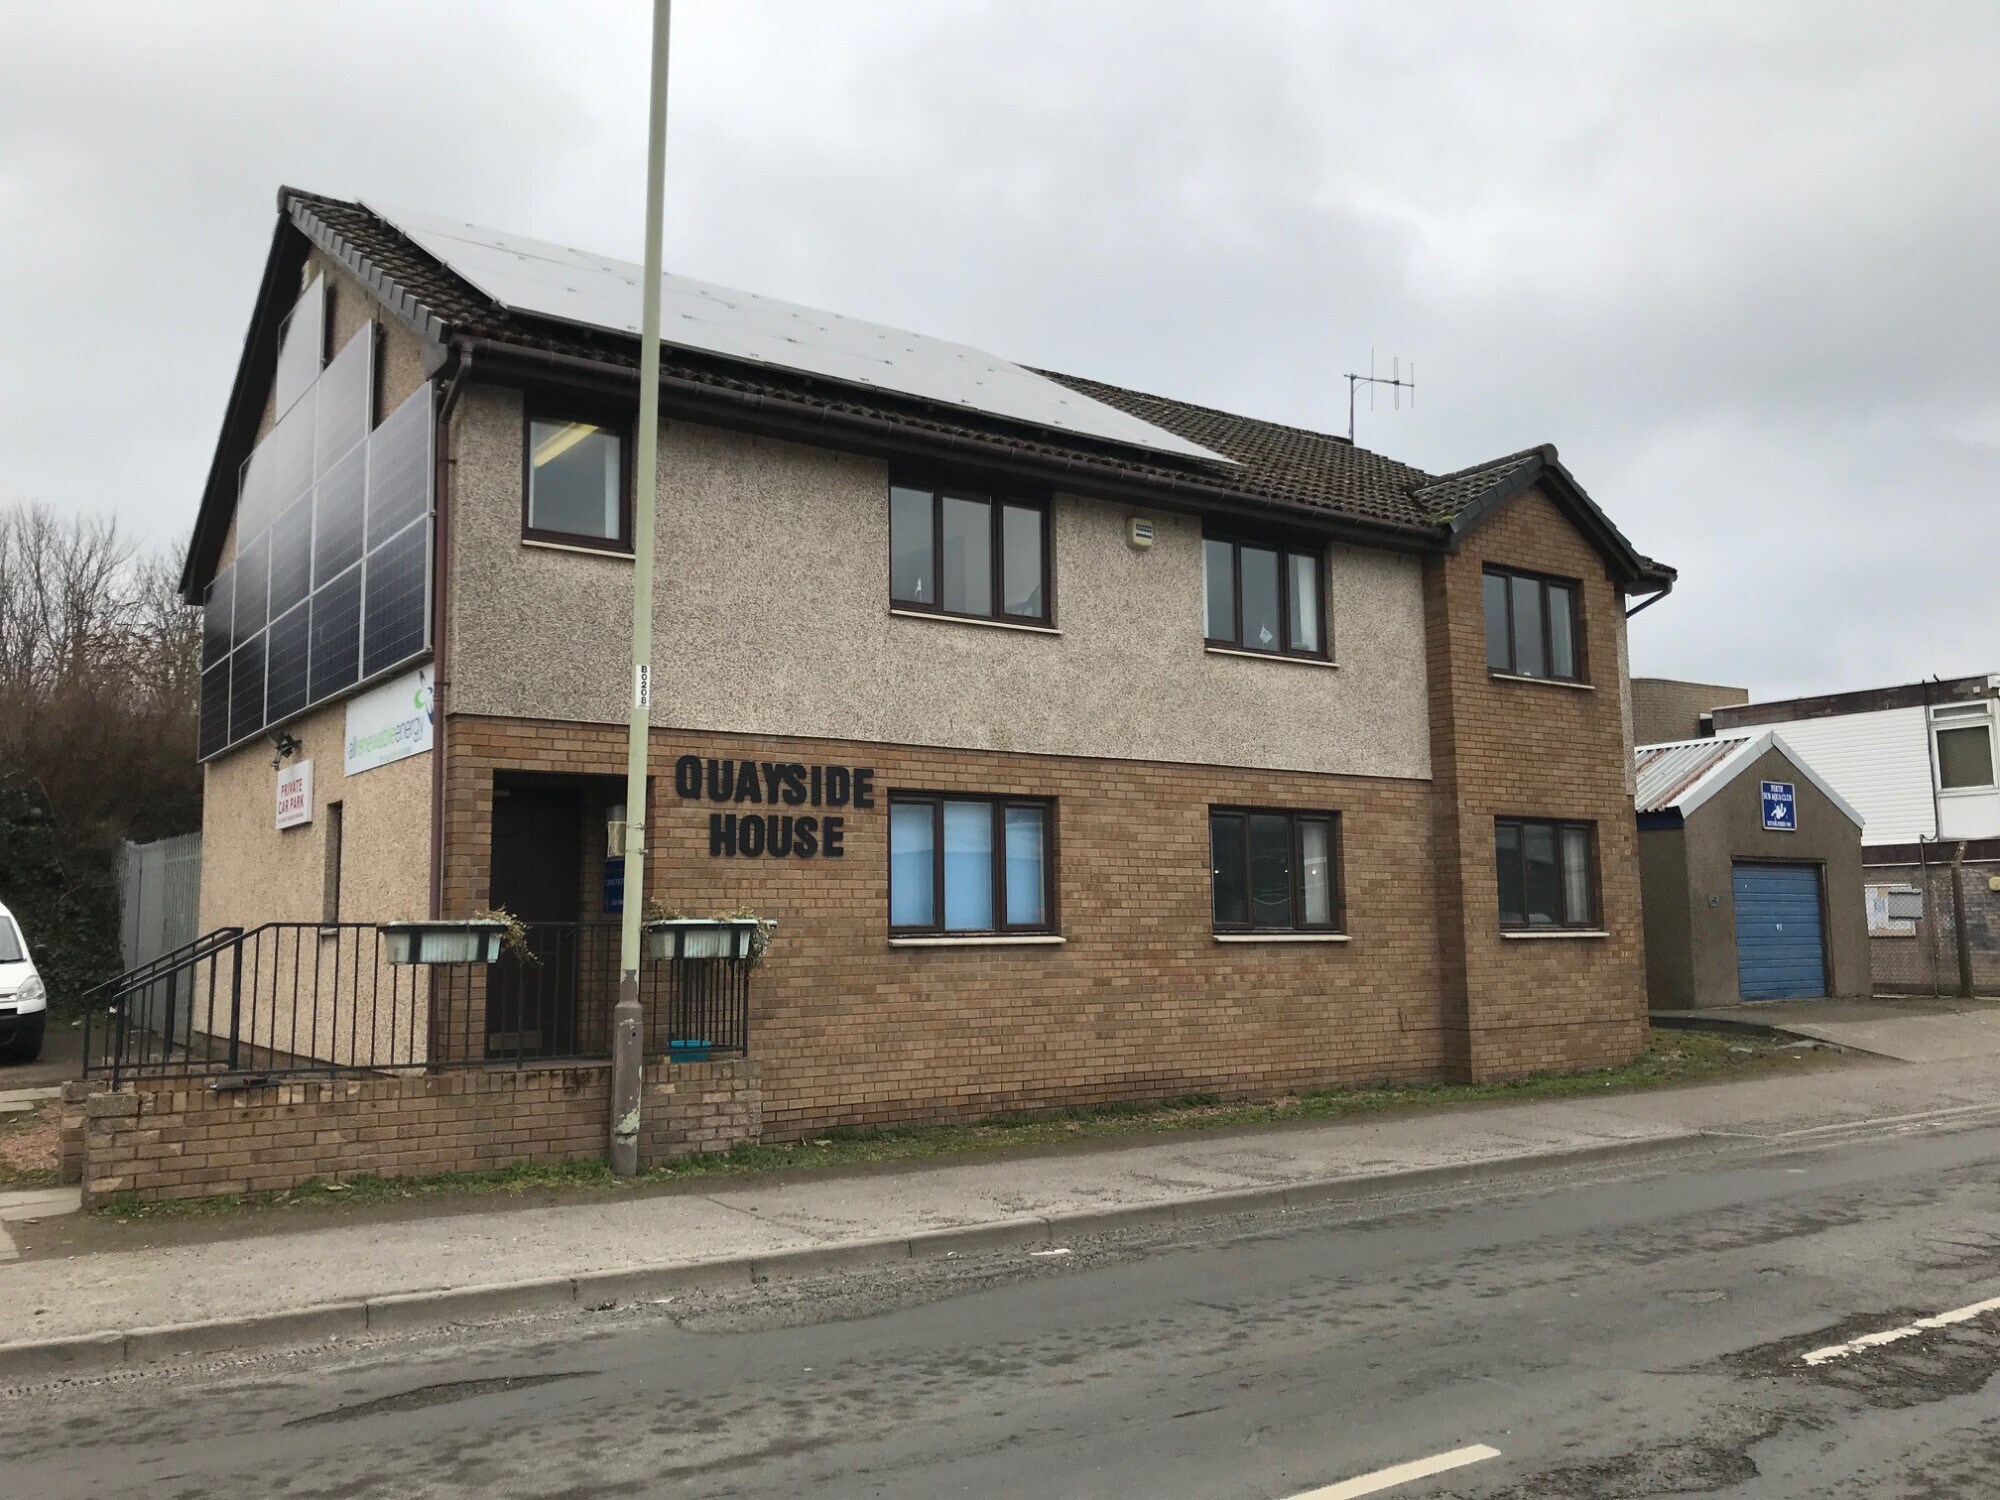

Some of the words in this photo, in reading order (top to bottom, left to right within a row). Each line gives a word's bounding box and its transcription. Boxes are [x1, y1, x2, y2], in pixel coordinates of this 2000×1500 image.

[281, 778, 303, 799] PRIVATE
[675, 755, 875, 808] QUAYSIDE
[279, 799, 289, 815] CAR
[290, 794, 304, 811] PARK
[709, 813, 845, 858] HOUSE
